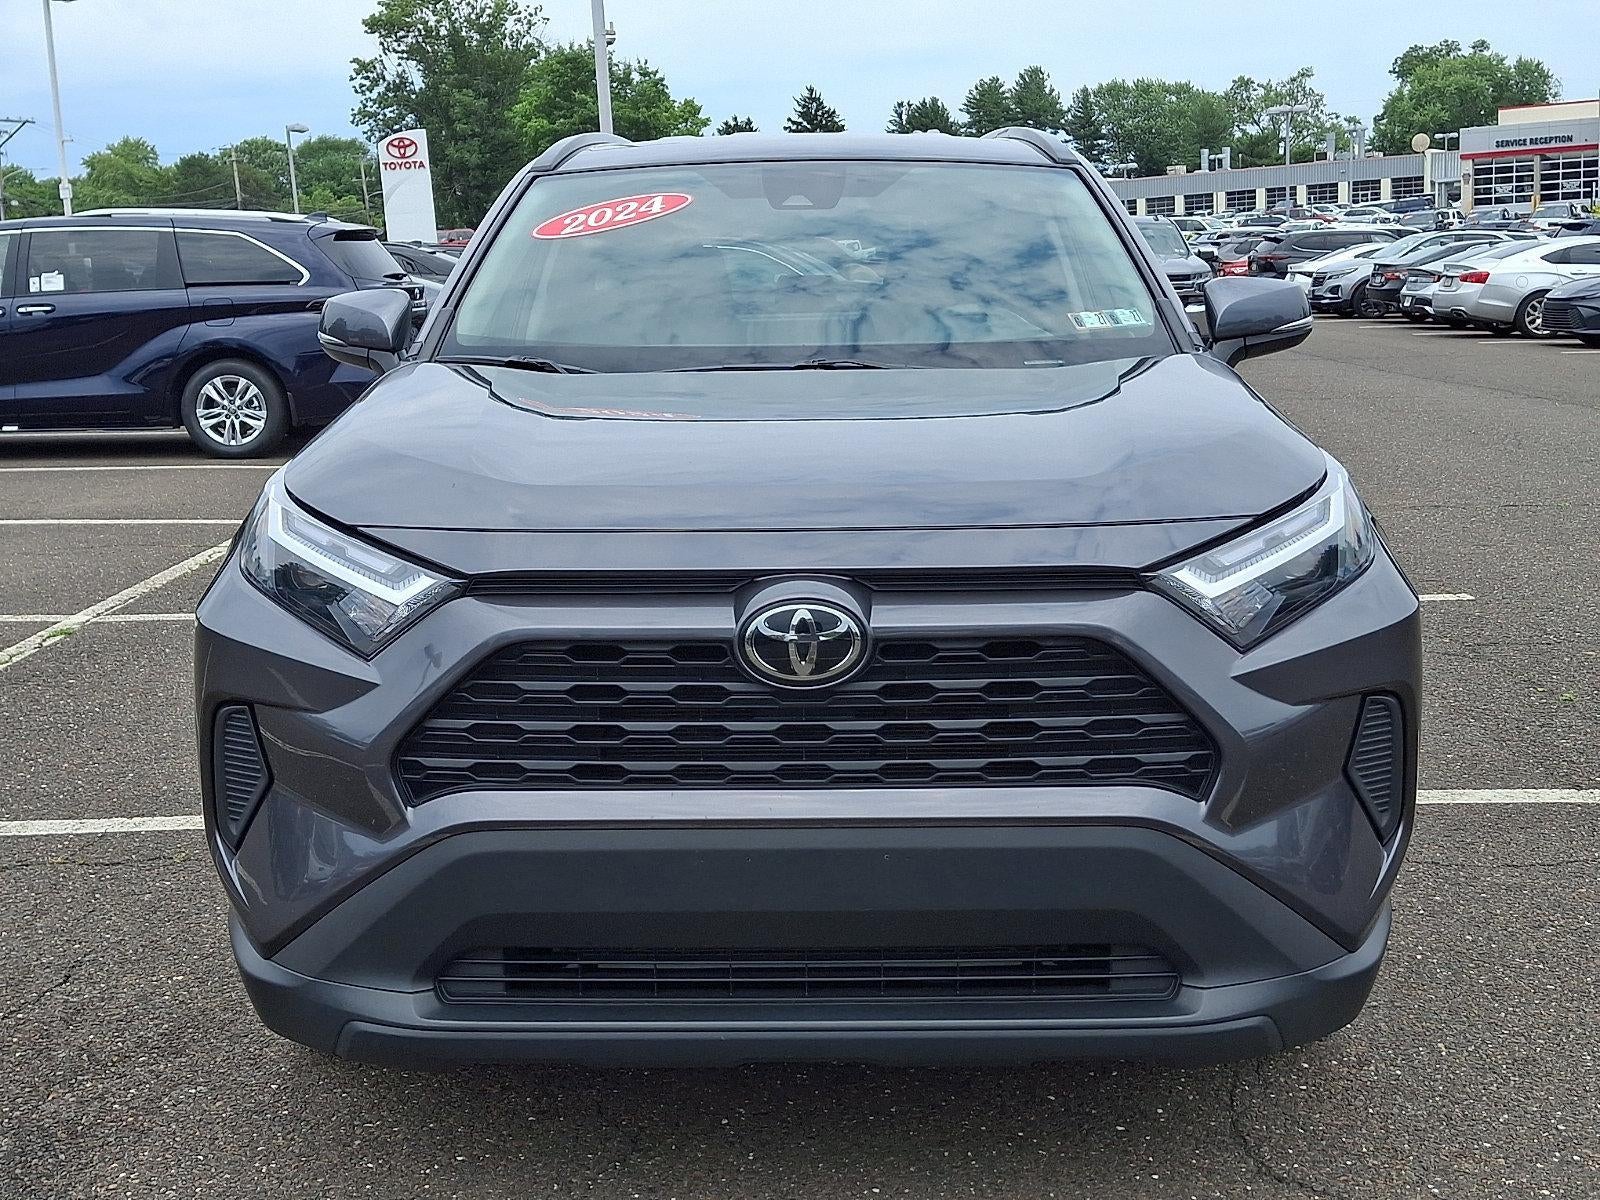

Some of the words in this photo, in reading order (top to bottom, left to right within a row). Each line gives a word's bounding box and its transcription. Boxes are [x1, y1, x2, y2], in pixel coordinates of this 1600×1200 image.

[1495, 138, 1527, 148] SERVICE
[1529, 134, 1573, 145] RECEPTION
[382, 160, 426, 171] TOYOTA
[560, 195, 666, 235] 2024
